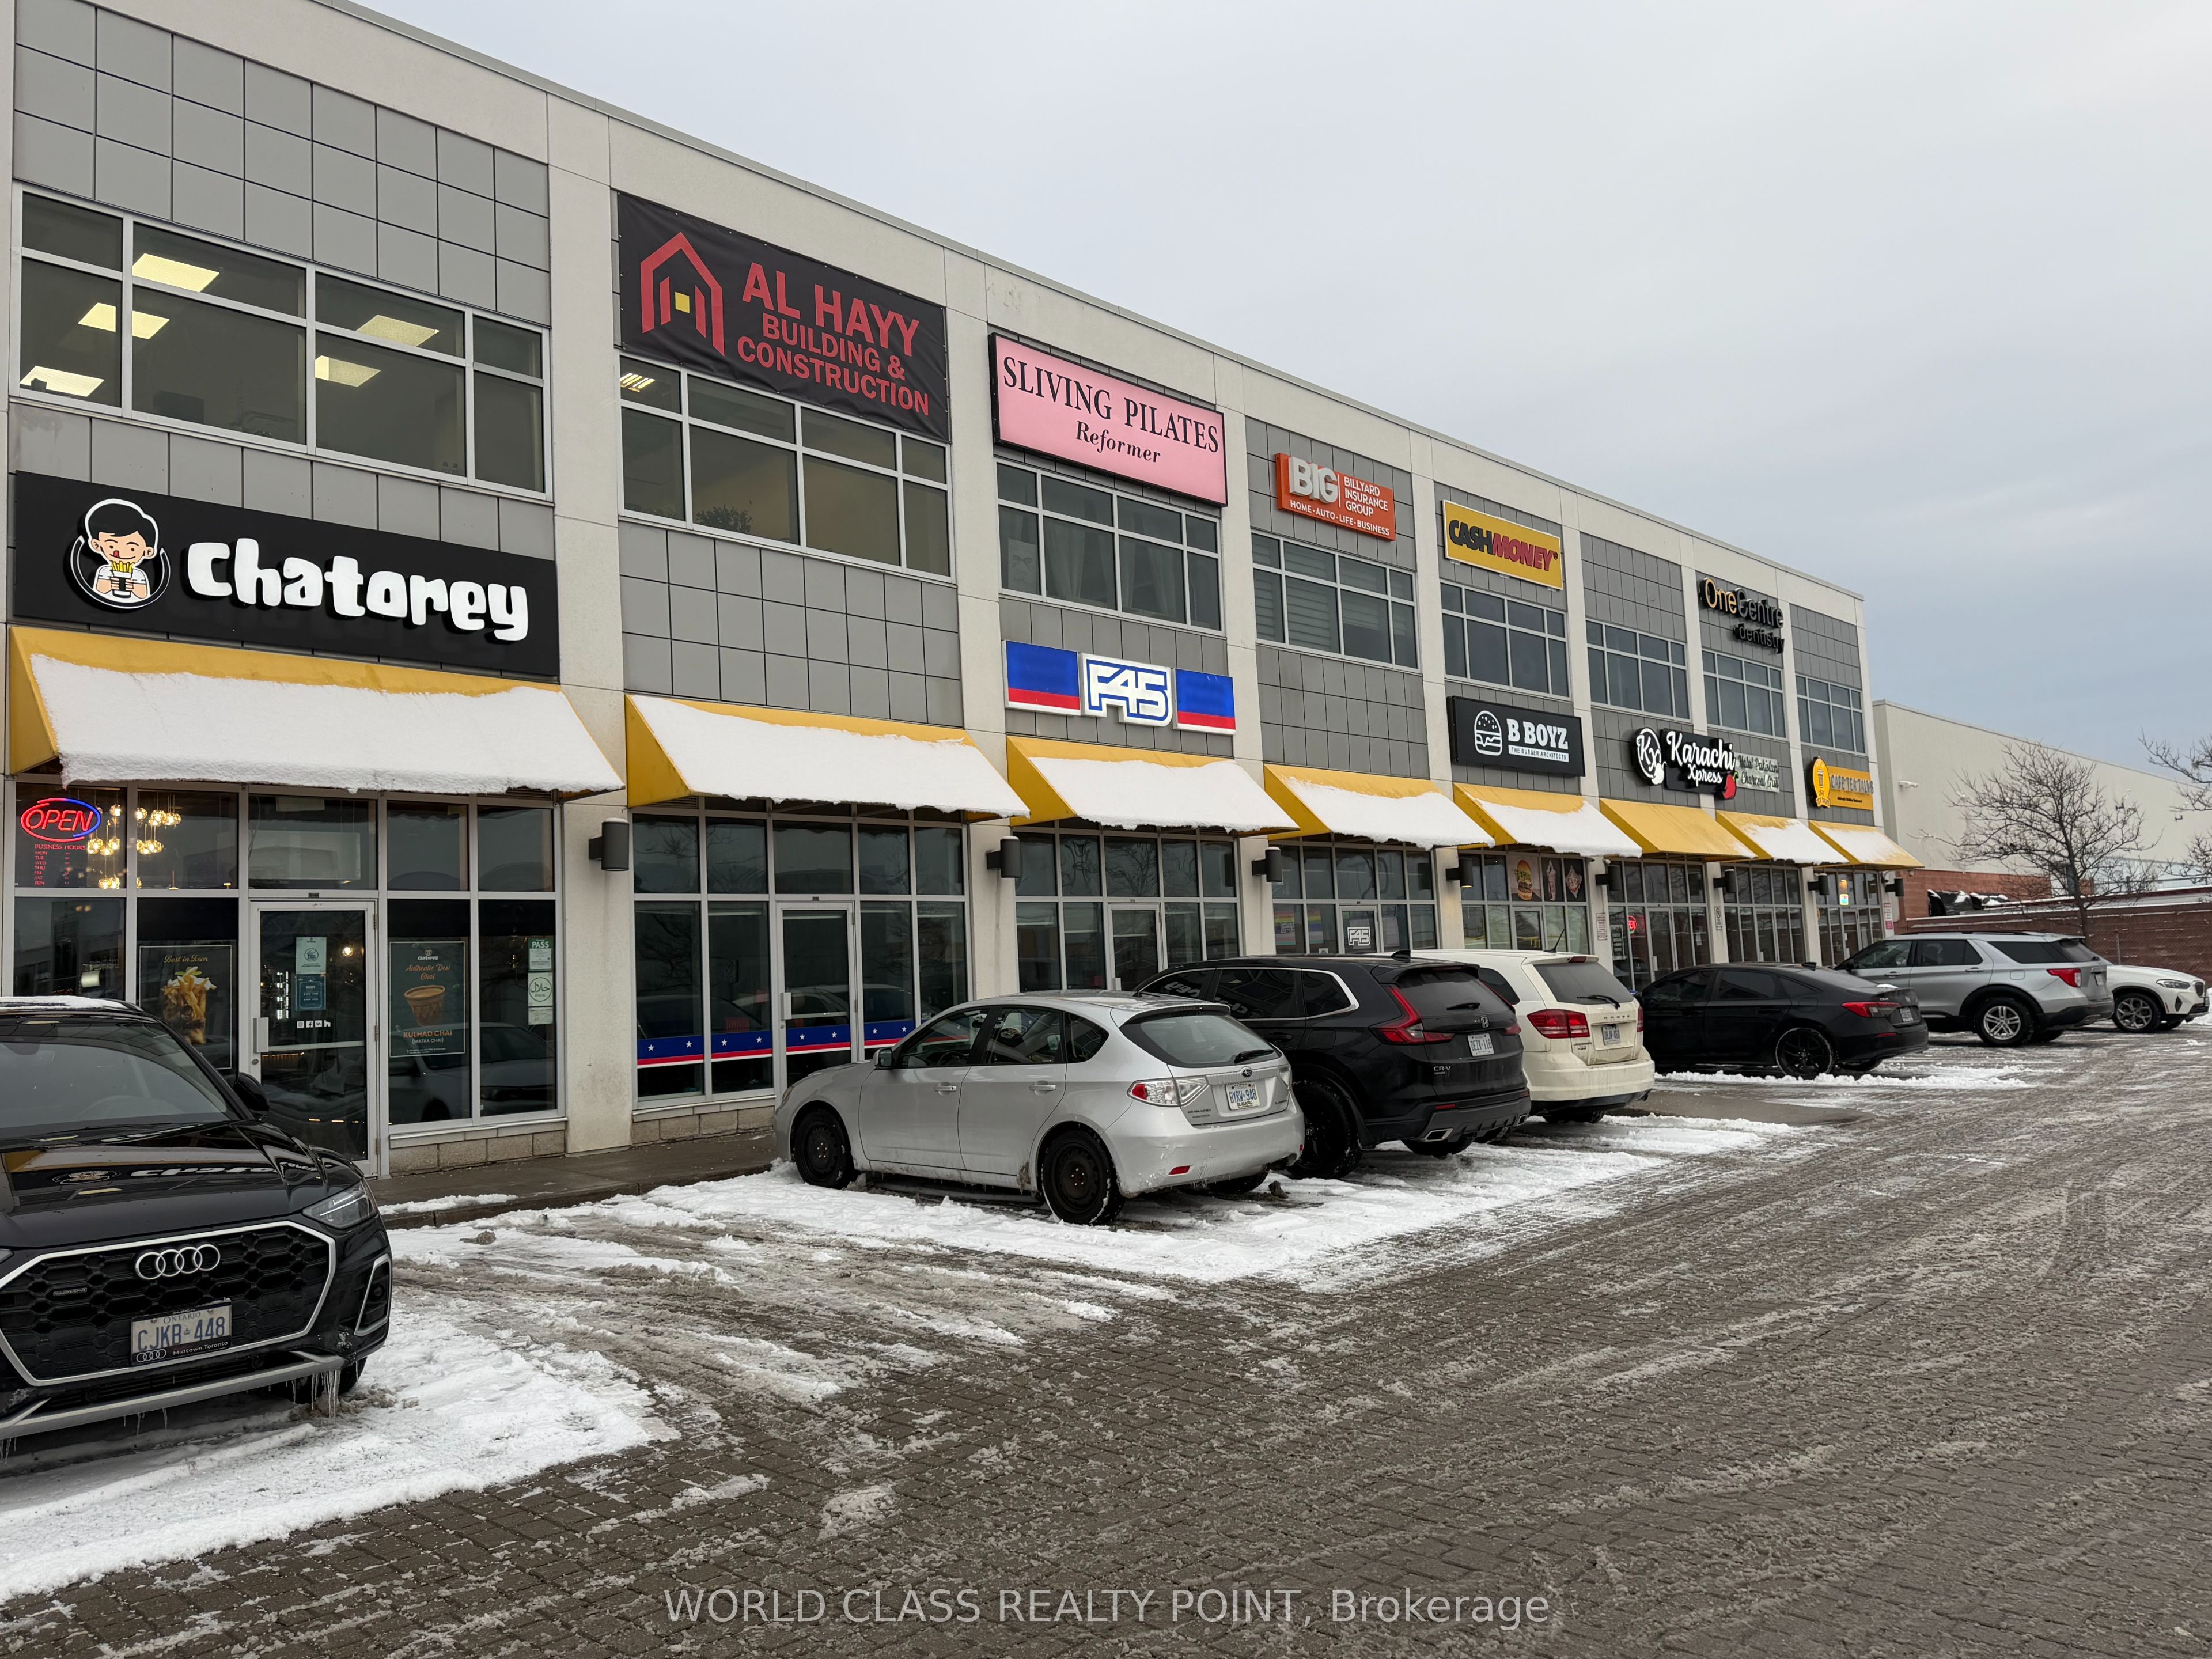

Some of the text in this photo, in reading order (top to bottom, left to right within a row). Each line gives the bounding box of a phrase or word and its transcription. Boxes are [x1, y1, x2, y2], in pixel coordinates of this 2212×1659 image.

[742, 262, 919, 356] AL HAYY
[763, 313, 906, 380] BUILDING &
[738, 336, 929, 415] CONSTRUCTION
[1003, 356, 1219, 453] SLIVING PILATES
[1075, 421, 1160, 463] Reformer
[1288, 456, 1338, 503] BIG
[1344, 476, 1380, 497] BILLYARD
[1344, 488, 1388, 511] INSURANCE
[1345, 501, 1374, 517] GROUP
[1290, 500, 1389, 536] HOME AUTO LIFE BUSINESS
[1736, 623, 1785, 654] dentistry
[1086, 660, 1168, 721] F45
[1506, 718, 1569, 750] B BOYZ
[1521, 748, 1539, 756] BURGER
[1540, 751, 1566, 760] ARCHITECTS
[1666, 730, 1736, 770] Karachi
[1738, 755, 1753, 770] Halal
[1688, 764, 1723, 787] Xpress
[1741, 771, 1779, 789] Charcoal Grill
[25, 809, 93, 831] OPEN
[1348, 926, 1370, 946] F45
[164, 955, 181, 963] Best
[190, 955, 208, 963] Town
[163, 1312, 201, 1324] ONTARIO
[138, 1316, 225, 1351] CJKB 448
[173, 1341, 228, 1355] Midtown Toronto
